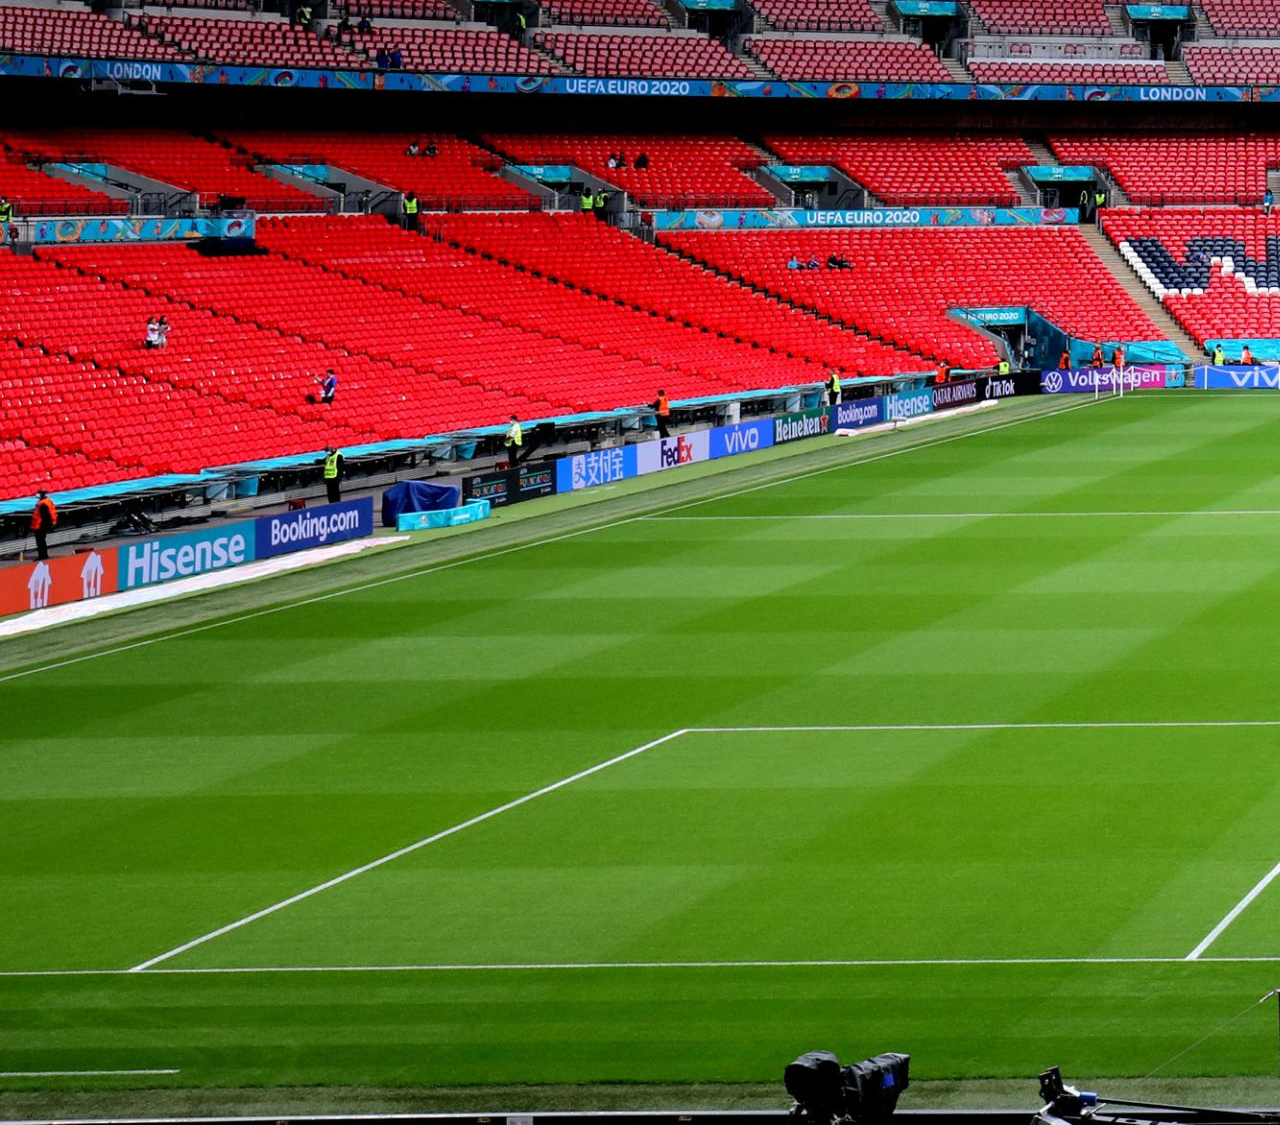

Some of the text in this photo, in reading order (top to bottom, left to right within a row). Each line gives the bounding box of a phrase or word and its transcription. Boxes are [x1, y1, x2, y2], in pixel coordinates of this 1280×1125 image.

[106, 62, 162, 80] LONDON
[566, 79, 690, 95] UEFA EURO 2020
[1139, 87, 1207, 101] LONDON
[806, 211, 920, 224] UEFA EURO 2020
[999, 312, 1019, 320] 2020
[992, 378, 1015, 397] TikTok
[1068, 367, 1160, 387] Volkswagen
[932, 382, 977, 407] QATAR AIRWAYS
[837, 403, 878, 425] Booking.com
[886, 392, 930, 421] Hisense
[724, 425, 759, 453] vivo
[775, 413, 821, 443] Heineken
[661, 435, 694, 468] FedEx
[586, 450, 625, 486] 支付宝
[271, 507, 359, 547] Booking.com
[127, 534, 245, 587] Hisense
